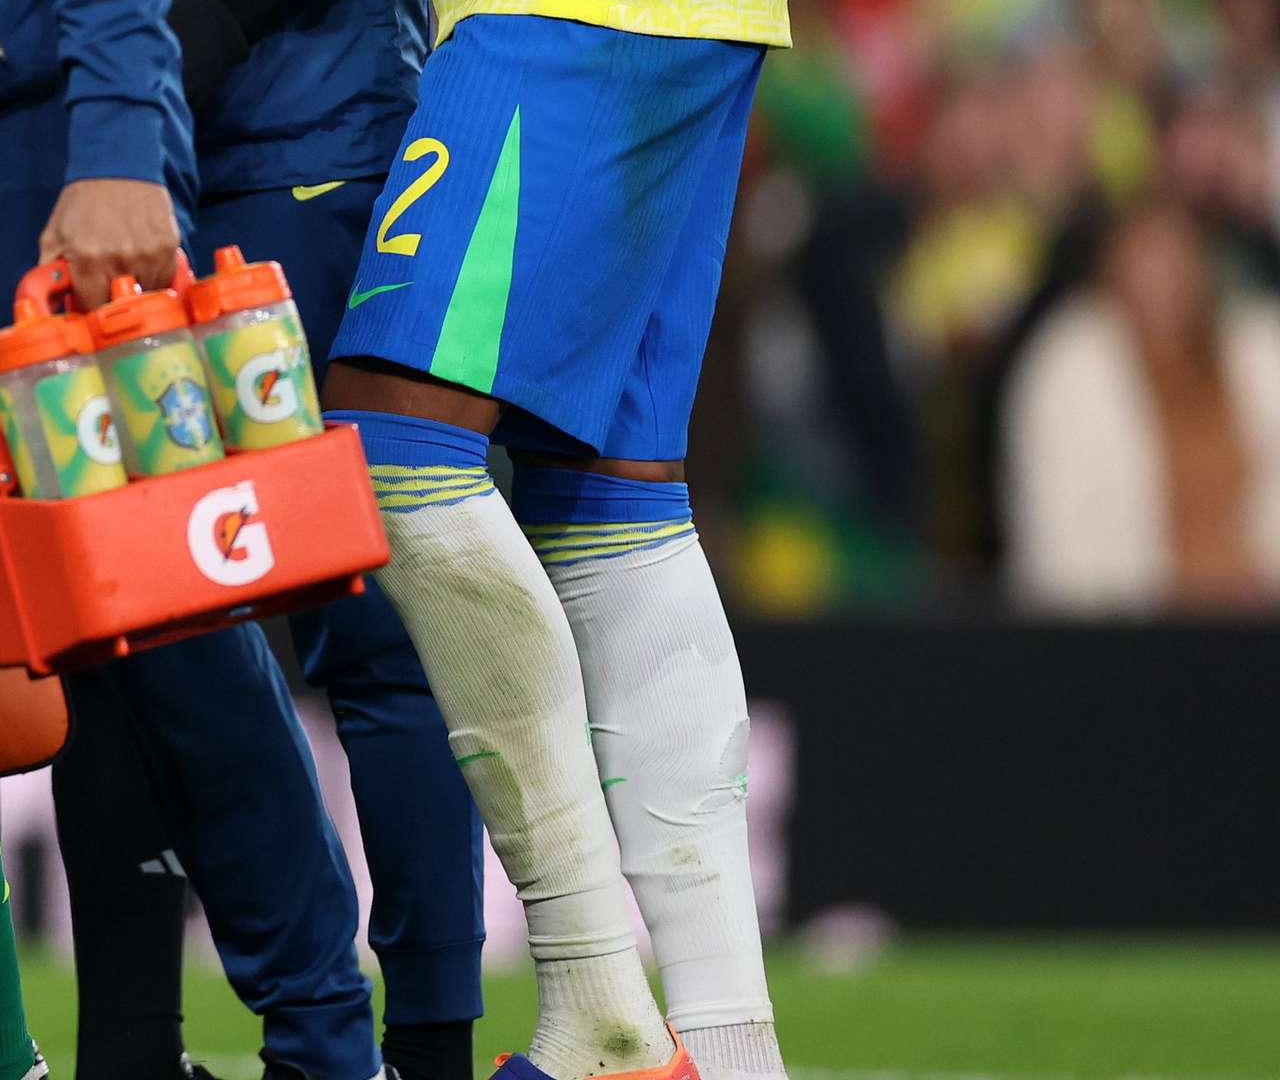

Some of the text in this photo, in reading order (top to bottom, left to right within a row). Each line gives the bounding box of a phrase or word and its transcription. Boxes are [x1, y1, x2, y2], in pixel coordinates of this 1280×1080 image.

[376, 137, 450, 257] 2
[235, 347, 299, 425] G
[187, 479, 276, 587] G
